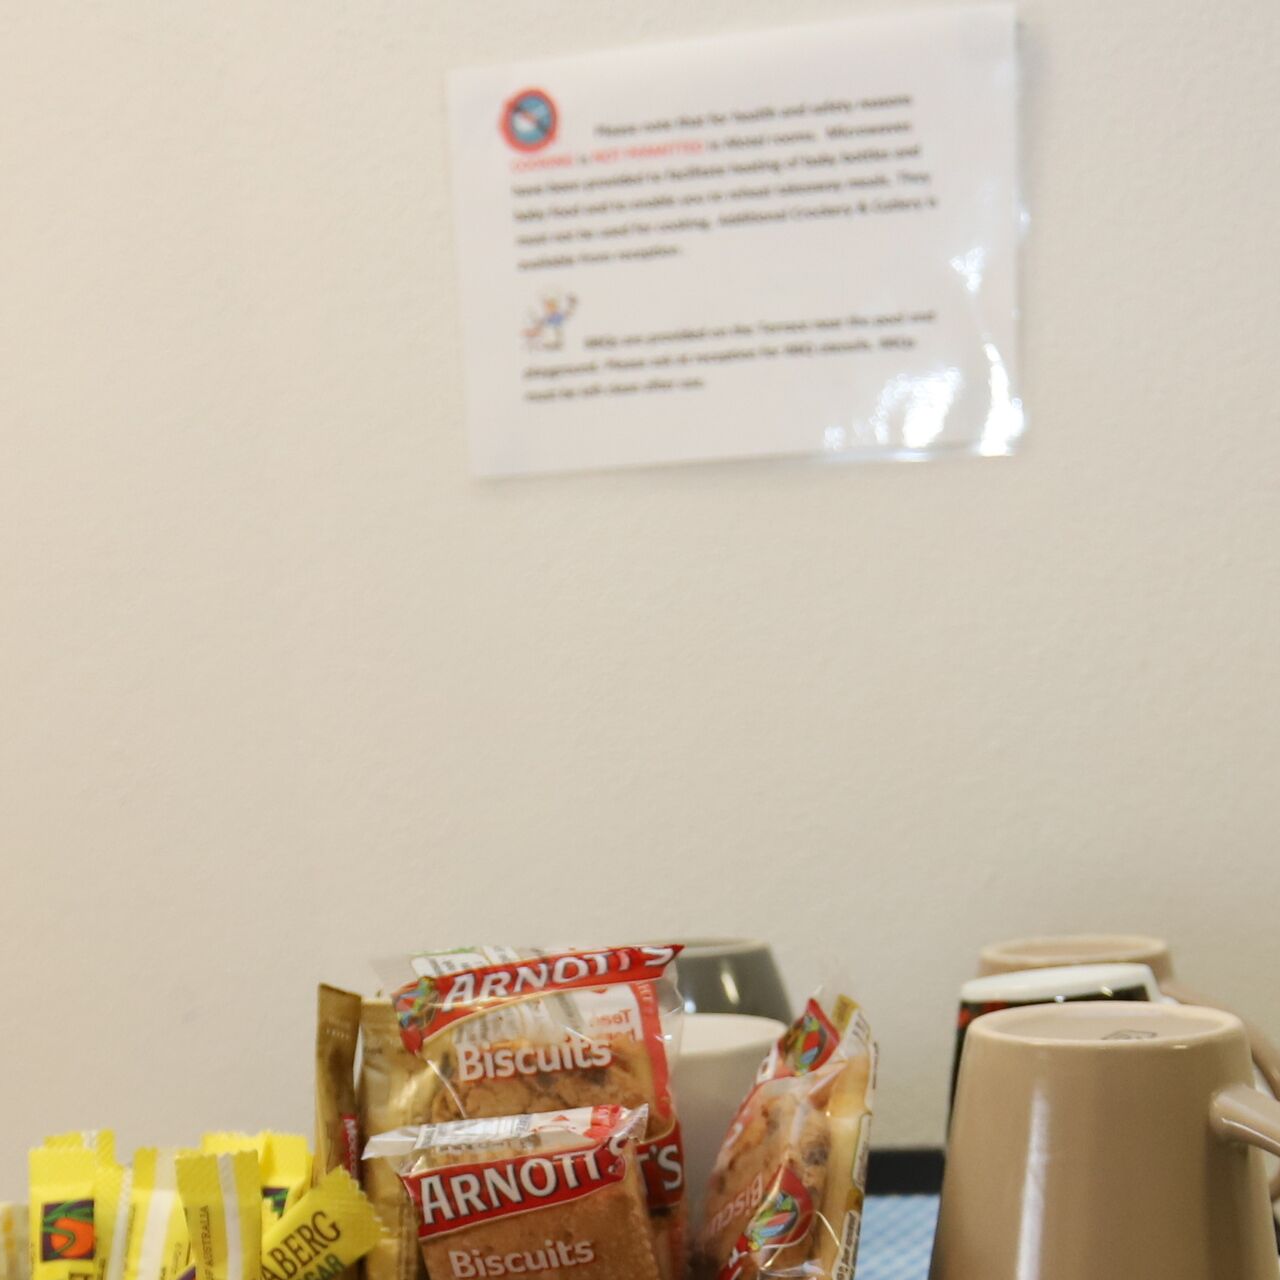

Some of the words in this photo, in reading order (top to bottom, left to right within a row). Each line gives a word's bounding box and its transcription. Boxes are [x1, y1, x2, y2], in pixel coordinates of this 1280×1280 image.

[455, 1036, 613, 1082] Biscuits
[199, 1205, 214, 1267] AUSTRALIA
[449, 1239, 596, 1279] Biscuits
